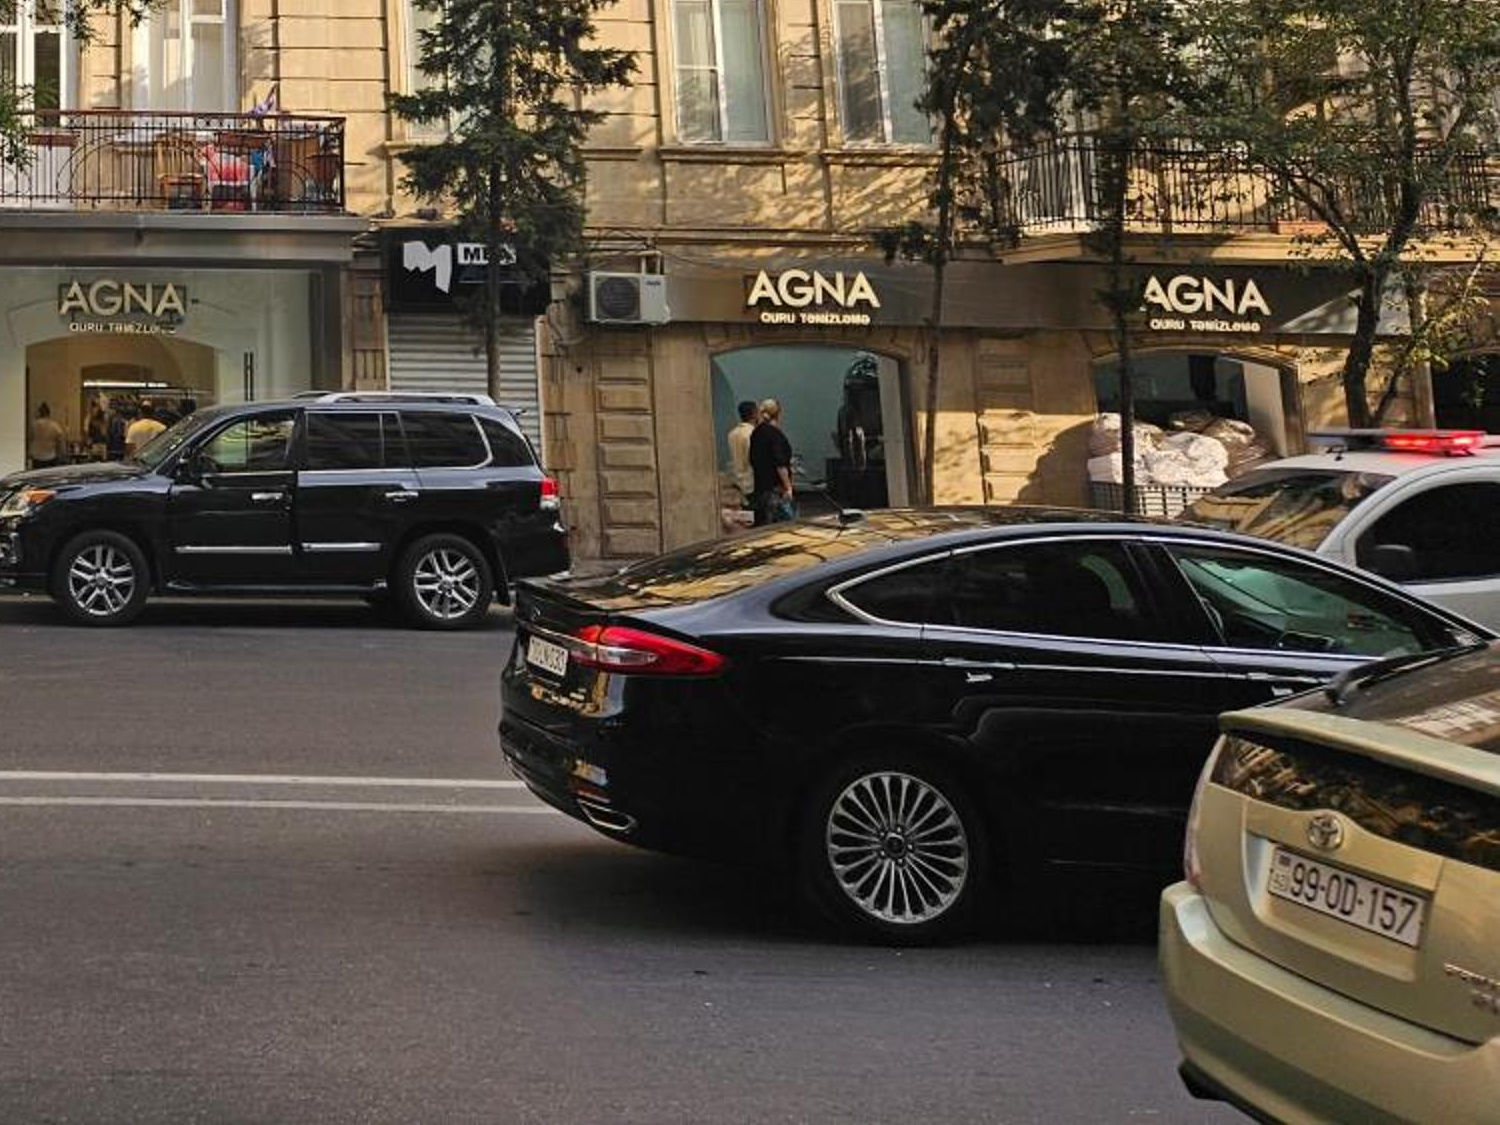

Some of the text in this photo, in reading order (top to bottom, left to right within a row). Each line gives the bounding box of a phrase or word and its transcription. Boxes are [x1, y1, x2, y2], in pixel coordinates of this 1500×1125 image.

[59, 280, 186, 316] AGNA
[747, 269, 881, 308] AGNA
[1139, 275, 1272, 315] AGNA
[69, 322, 103, 332] QURU
[761, 312, 795, 324] QURU
[1150, 318, 1184, 330] QURU
[1291, 862, 1418, 935] 99-OD-157
